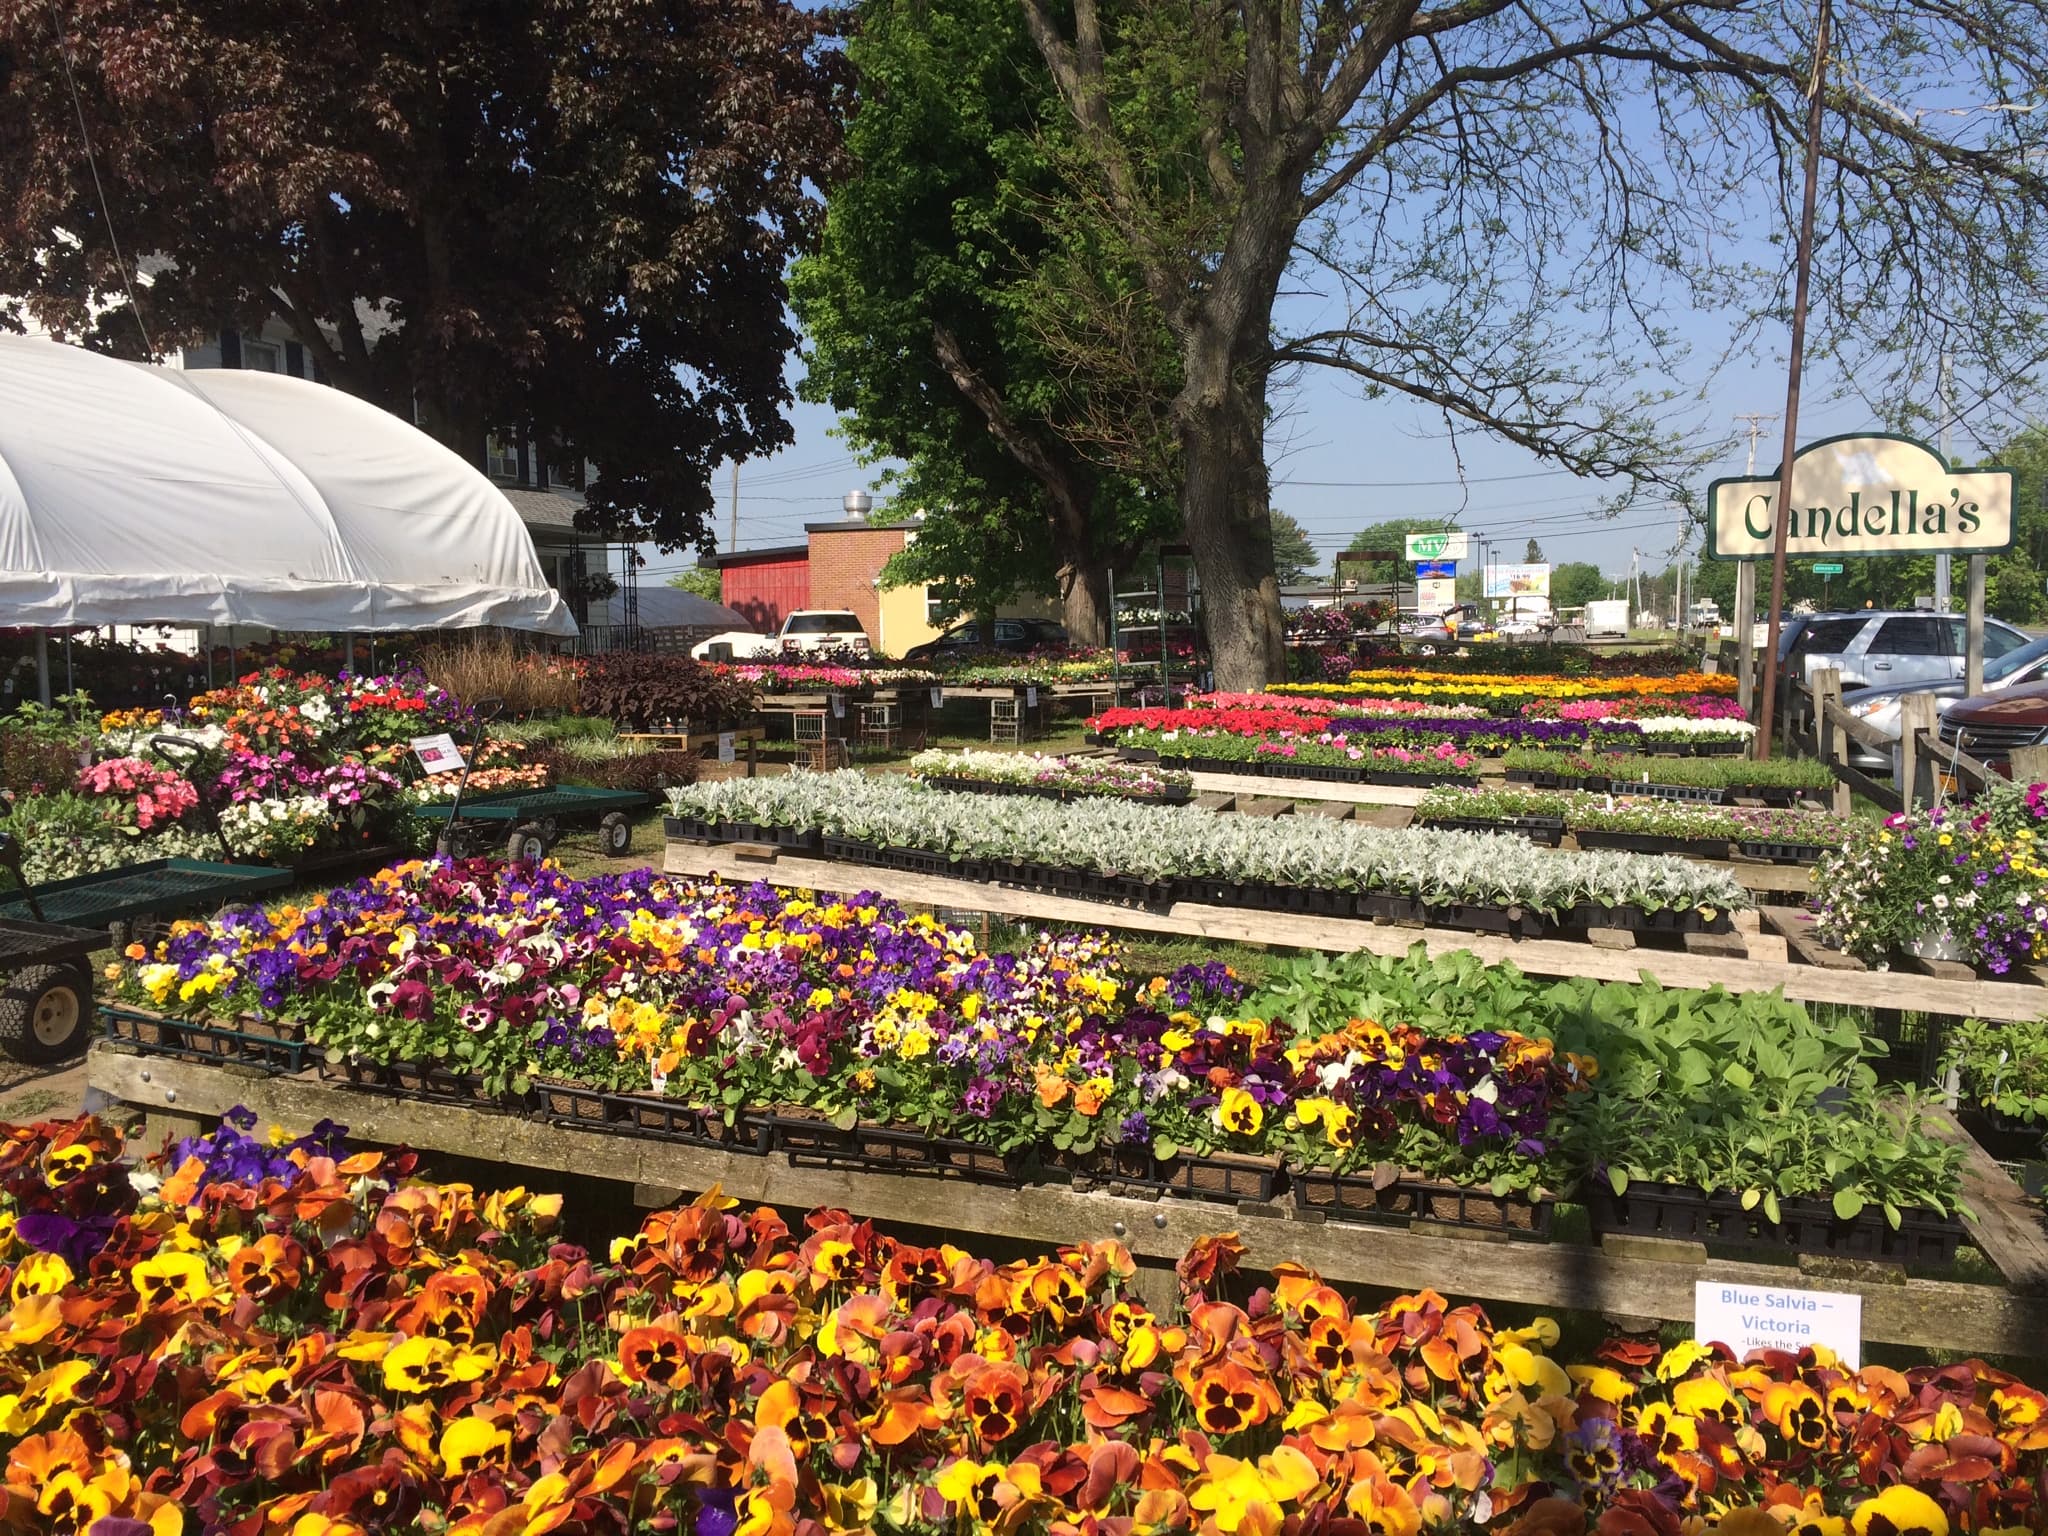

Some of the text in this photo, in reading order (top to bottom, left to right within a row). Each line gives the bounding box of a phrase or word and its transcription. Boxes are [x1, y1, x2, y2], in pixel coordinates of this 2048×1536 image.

[1744, 487, 1981, 546] Candella's
[1721, 1289, 1760, 1306] Blue
[1765, 1293, 1817, 1311] Salvia
[1742, 1315, 1811, 1335] Victoria
[1775, 1339, 1793, 1349] the
